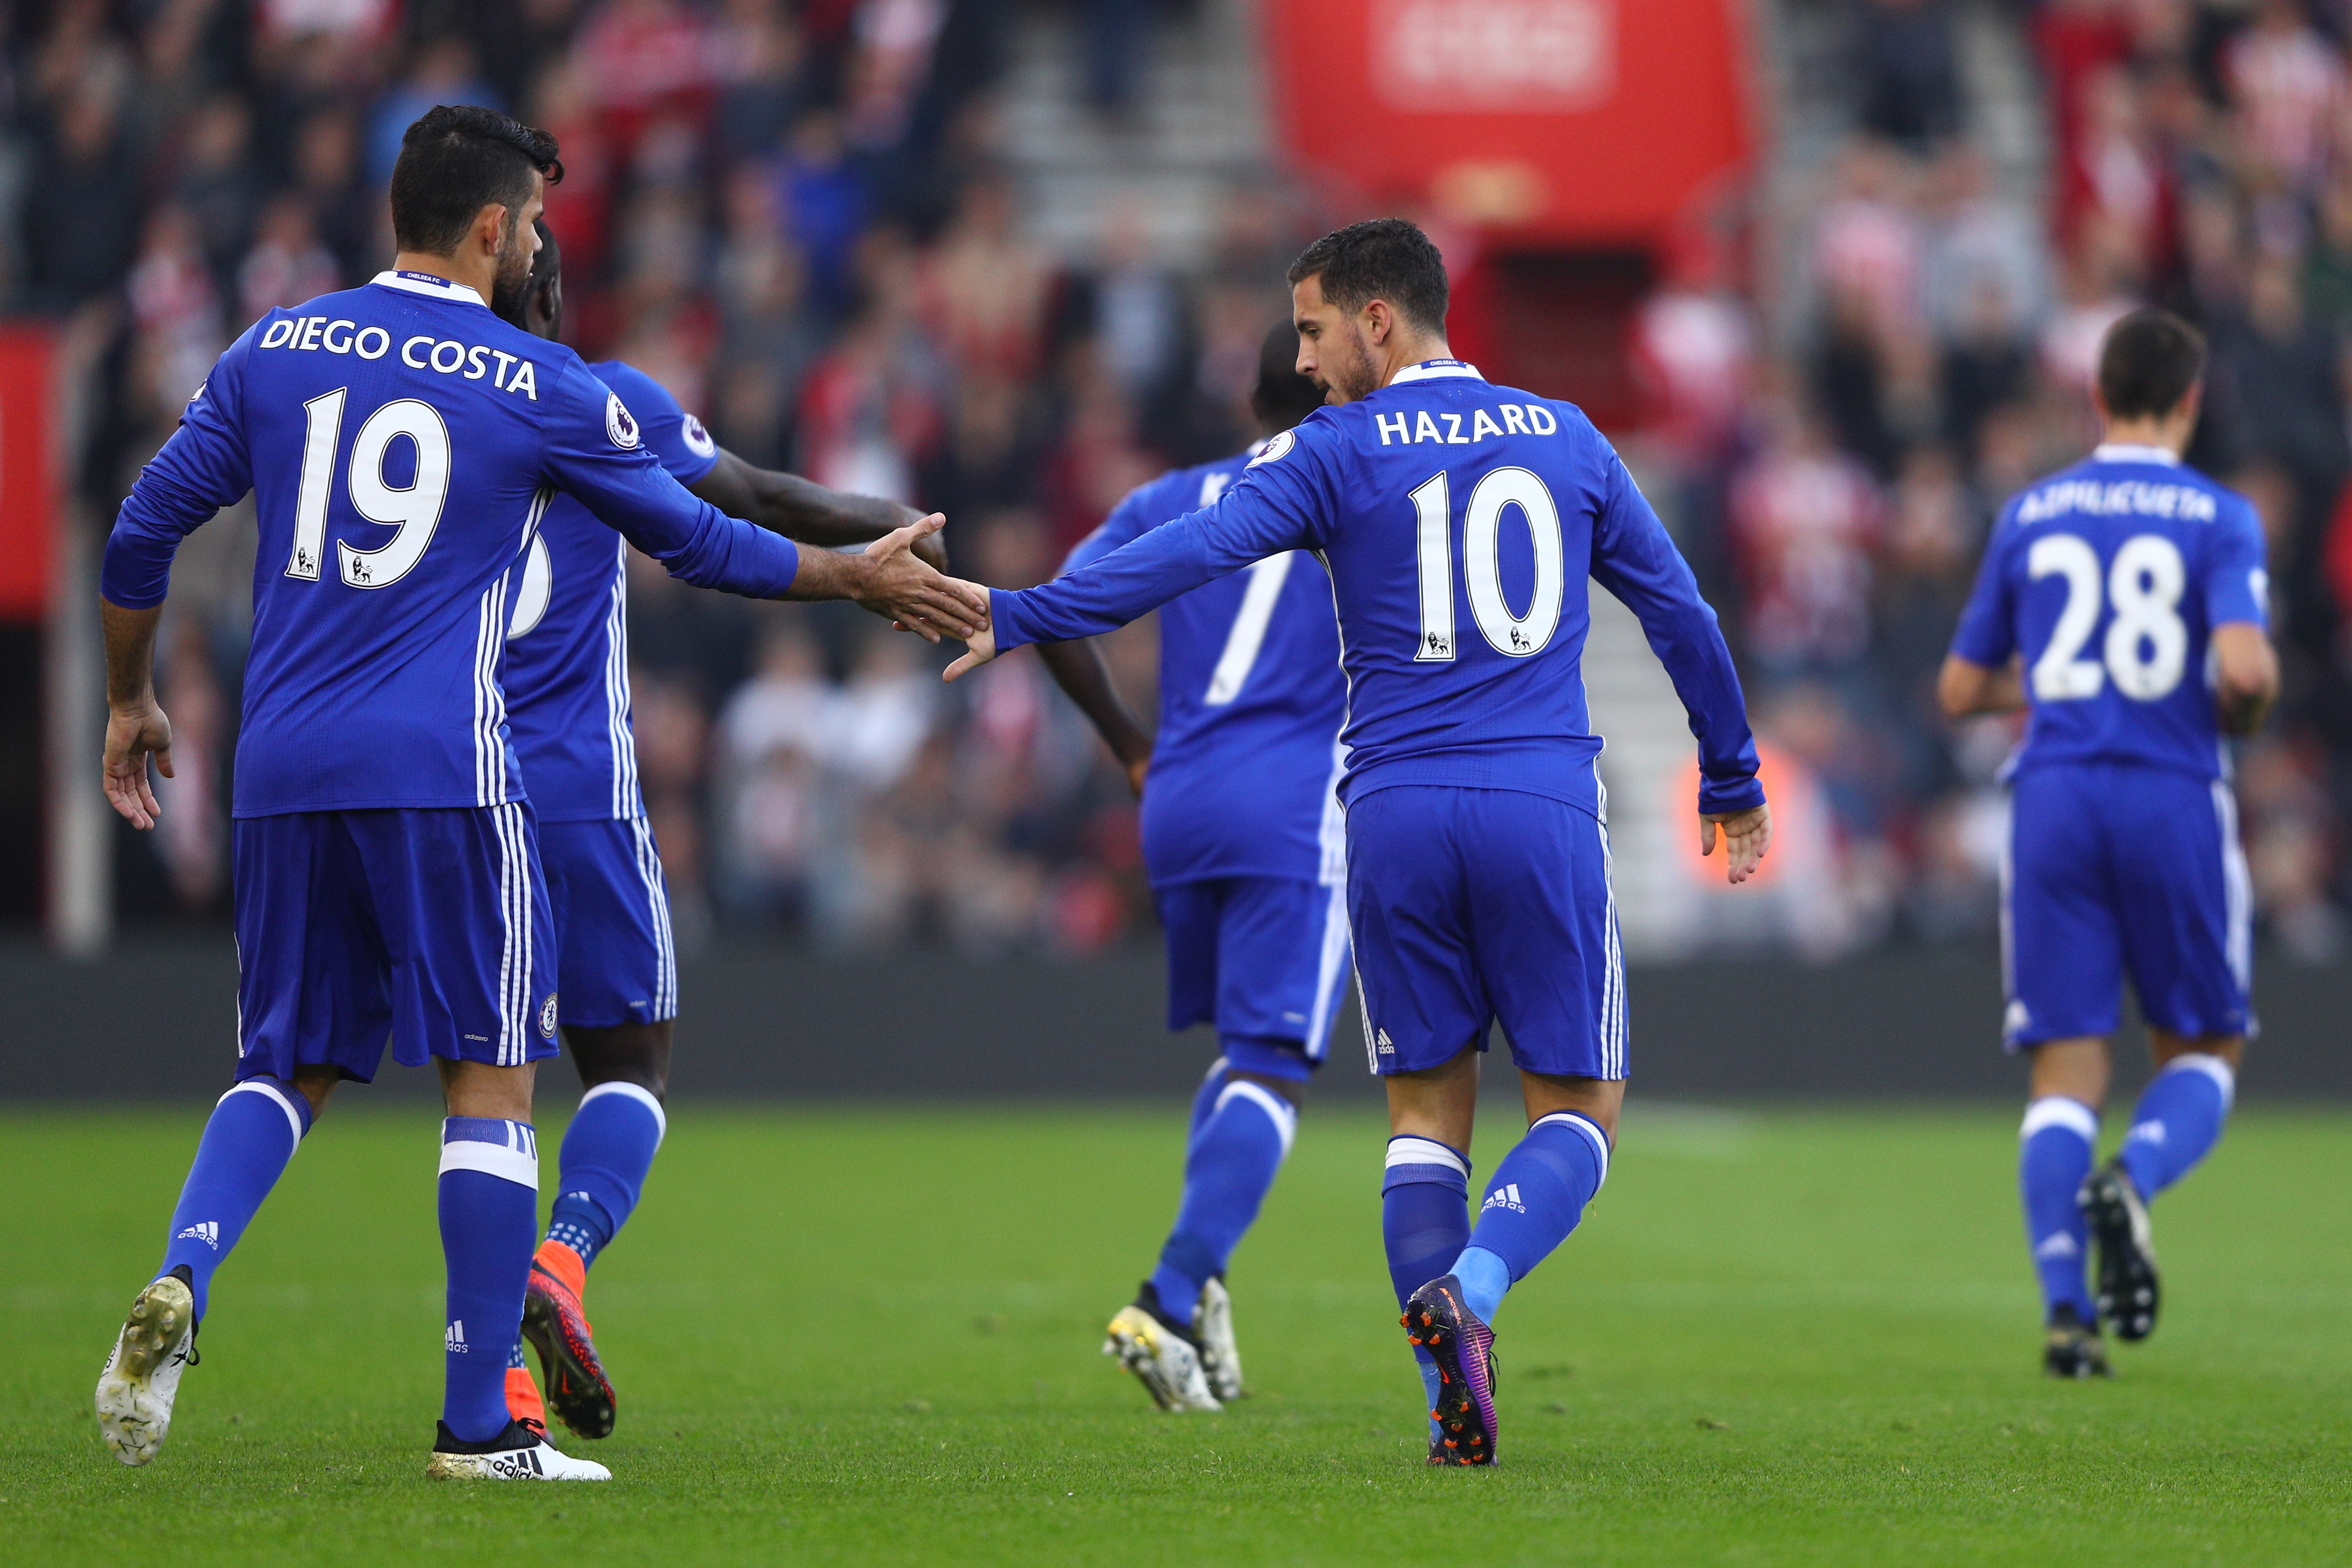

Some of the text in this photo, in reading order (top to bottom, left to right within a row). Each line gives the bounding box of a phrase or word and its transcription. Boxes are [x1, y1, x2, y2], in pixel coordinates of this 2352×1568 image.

[407, 273, 432, 282] CHELSEA
[259, 316, 538, 401] DIEGO COSTA
[1375, 403, 1557, 446] HAZARD
[285, 386, 451, 589] 19
[1408, 466, 1564, 661] 10
[1206, 550, 1294, 705] 7
[2028, 533, 2188, 702] 28
[1378, 1044, 1395, 1054] adida
[1481, 1199, 1526, 1213] adidas
[178, 1231, 218, 1250] adidas
[493, 1461, 534, 1479] adid
